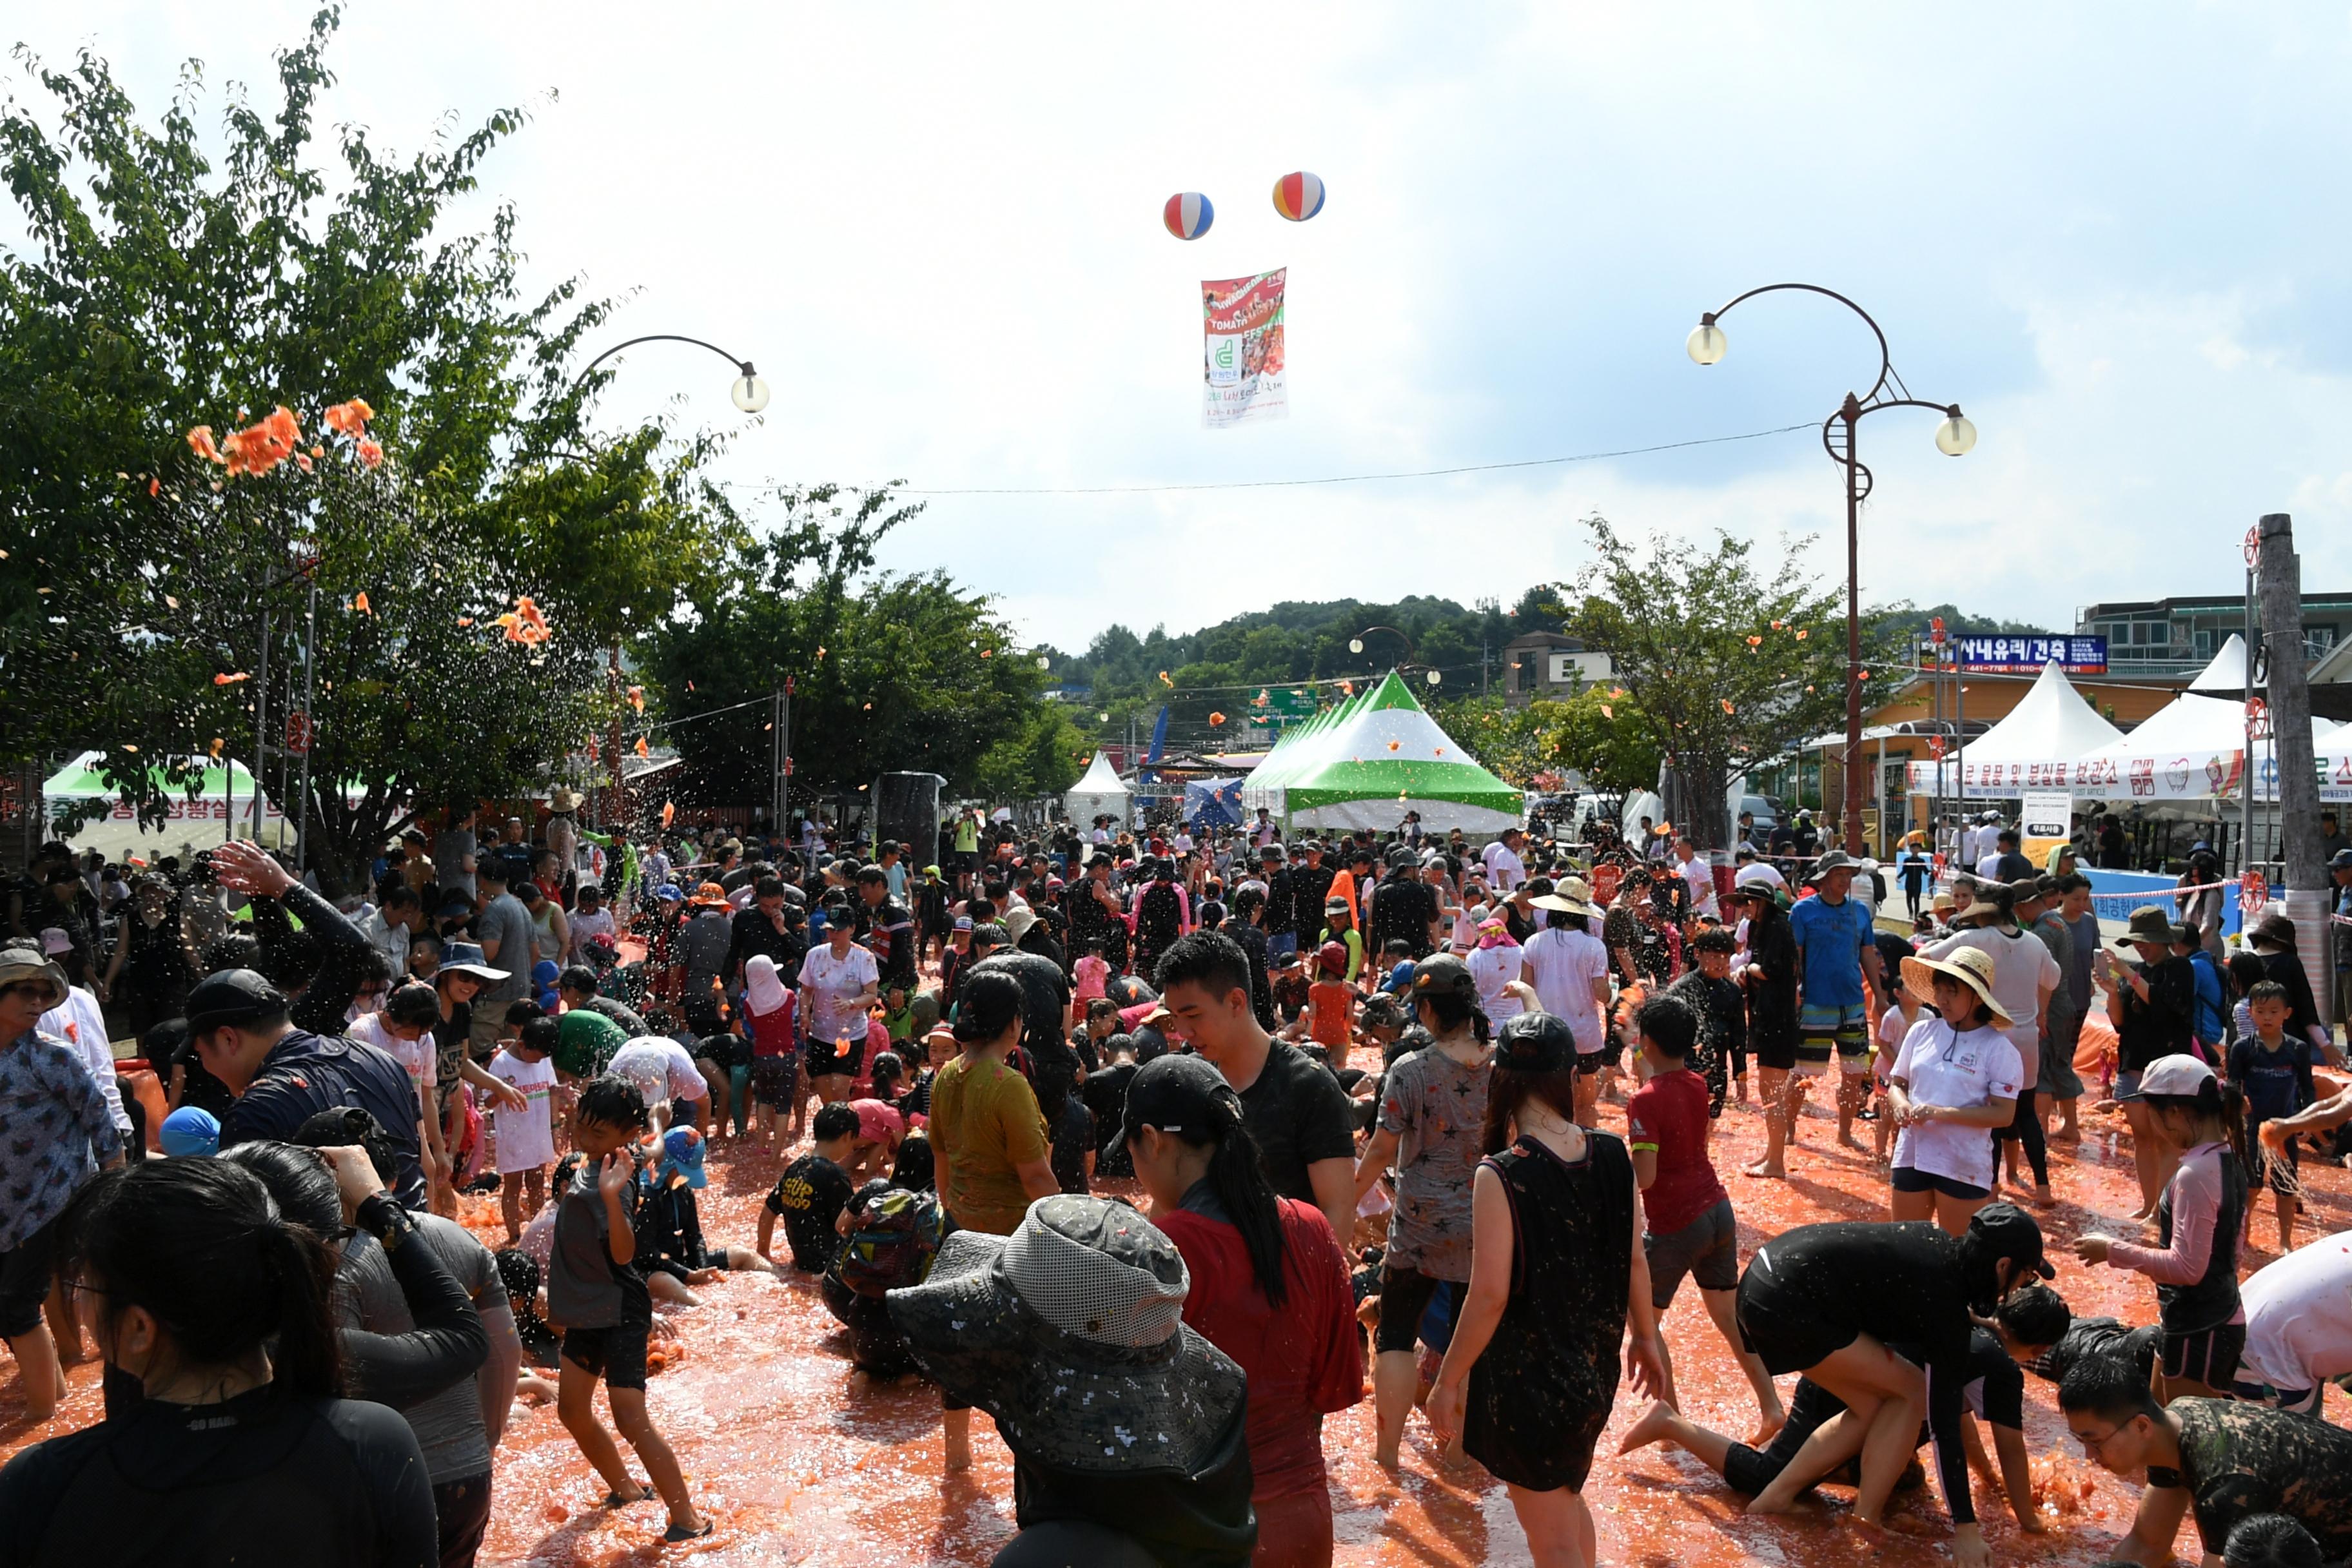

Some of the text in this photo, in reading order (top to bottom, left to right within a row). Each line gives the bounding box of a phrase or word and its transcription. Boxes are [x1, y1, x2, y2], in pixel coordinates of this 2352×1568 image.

[1981, 764, 2003, 786] 물품
[2028, 763, 2067, 786] 분실물
[2075, 760, 2119, 785] 보관소
